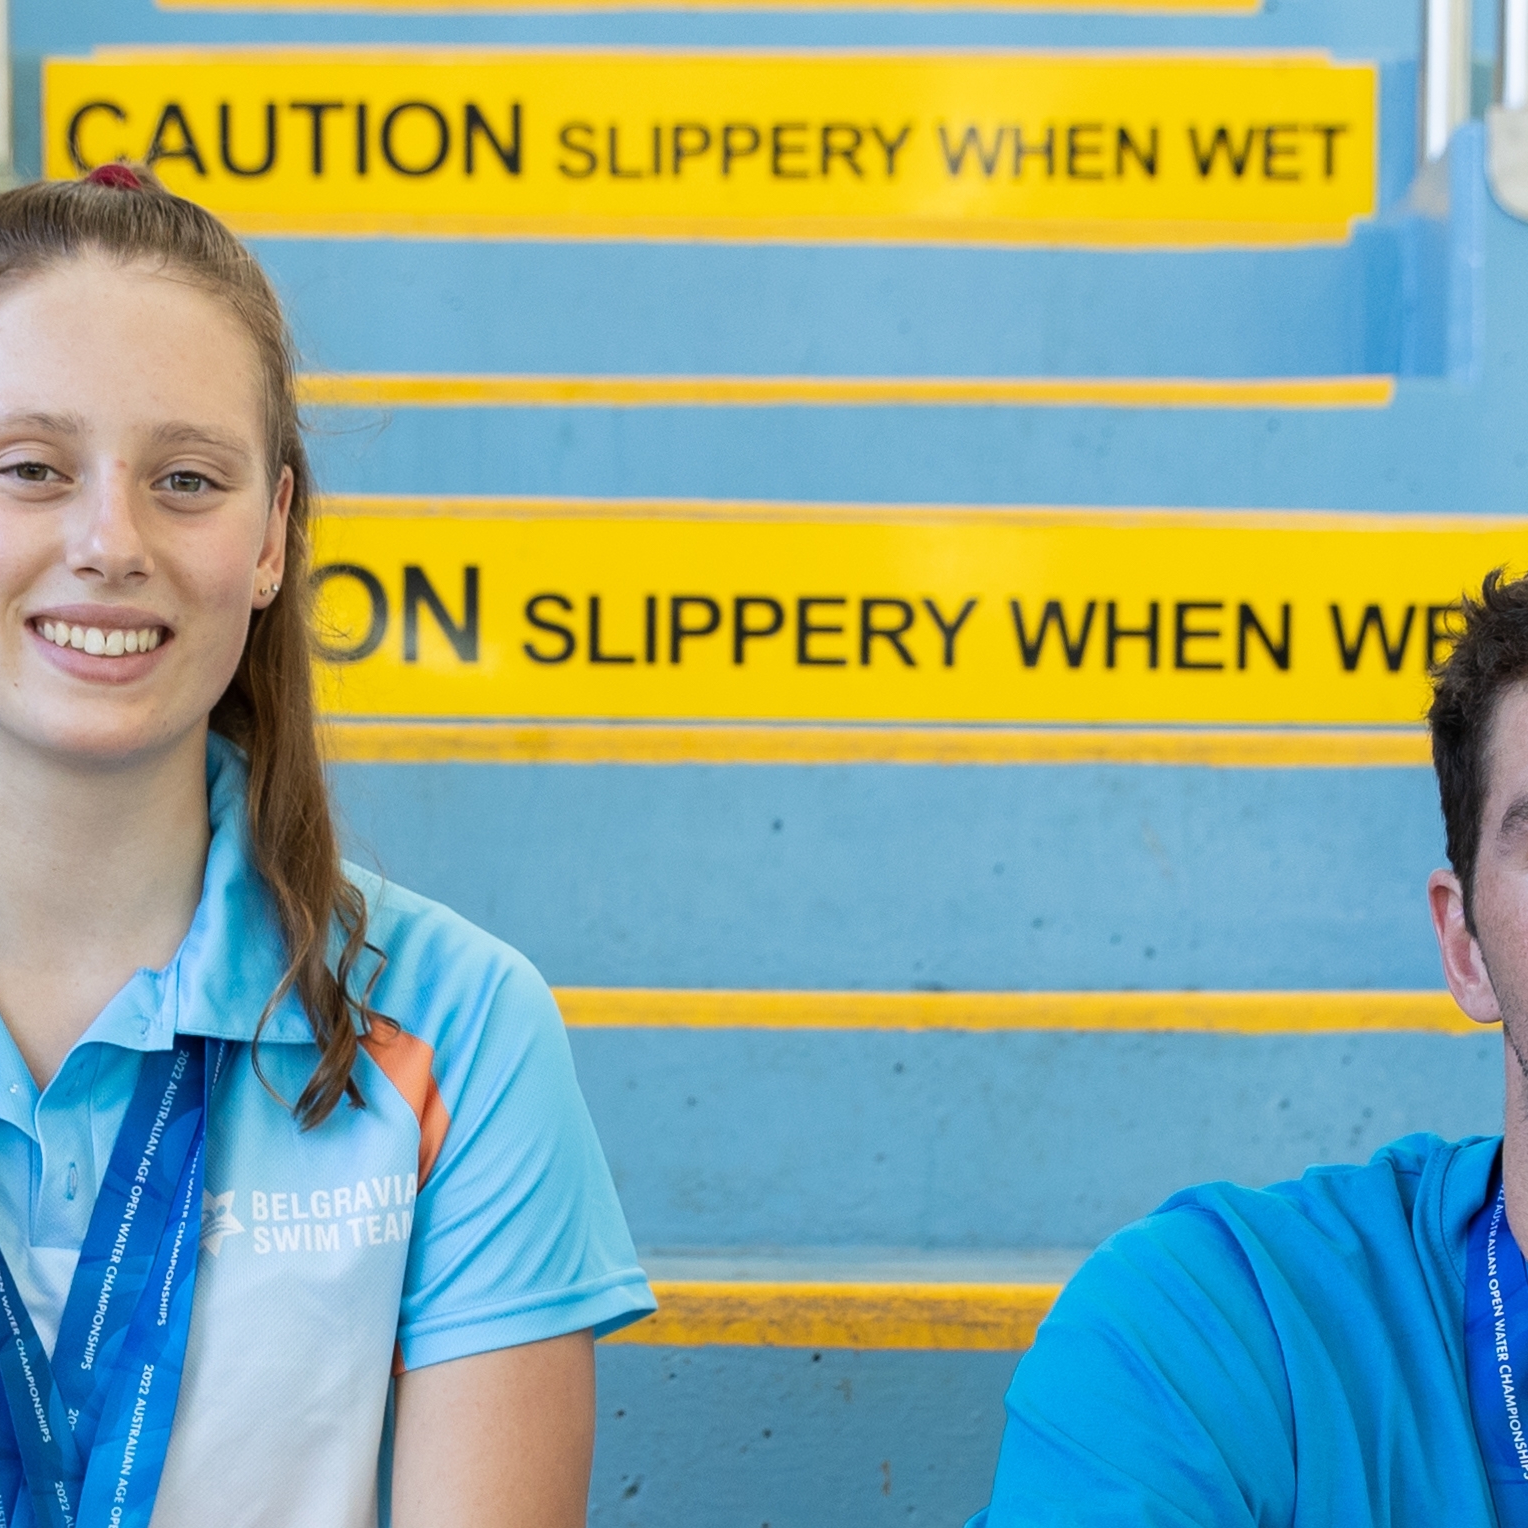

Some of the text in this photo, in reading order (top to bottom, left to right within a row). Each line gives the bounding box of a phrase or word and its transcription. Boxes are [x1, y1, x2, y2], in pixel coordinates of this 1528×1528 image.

[65, 99, 1348, 182] CAUTION SLIPPERY WHEN WET
[521, 591, 978, 668] SLIPPERY
[1010, 598, 1292, 672] WHEN
[81, 1049, 190, 1371] 2022 AUSTRALIAN AGE OPEN WATER CHAMPIONSHIPS
[252, 1172, 418, 1222] BELGRAVIA
[156, 1177, 195, 1327] WATER CHAMPIONSHIPS
[252, 1222, 341, 1255] SWIM
[1487, 1204, 1504, 1277] AUSTRALIAN
[1488, 1278, 1505, 1318] OPEN
[2, 1296, 20, 1335] WATER
[16, 1337, 52, 1443] CHAMPIONSHIPS
[1493, 1318, 1510, 1362] WATER
[138, 1364, 155, 1396] 2022
[120, 1397, 147, 1476] AUSTRALIAN
[54, 1480, 71, 1512] 2022
[113, 1477, 129, 1504] AGE
